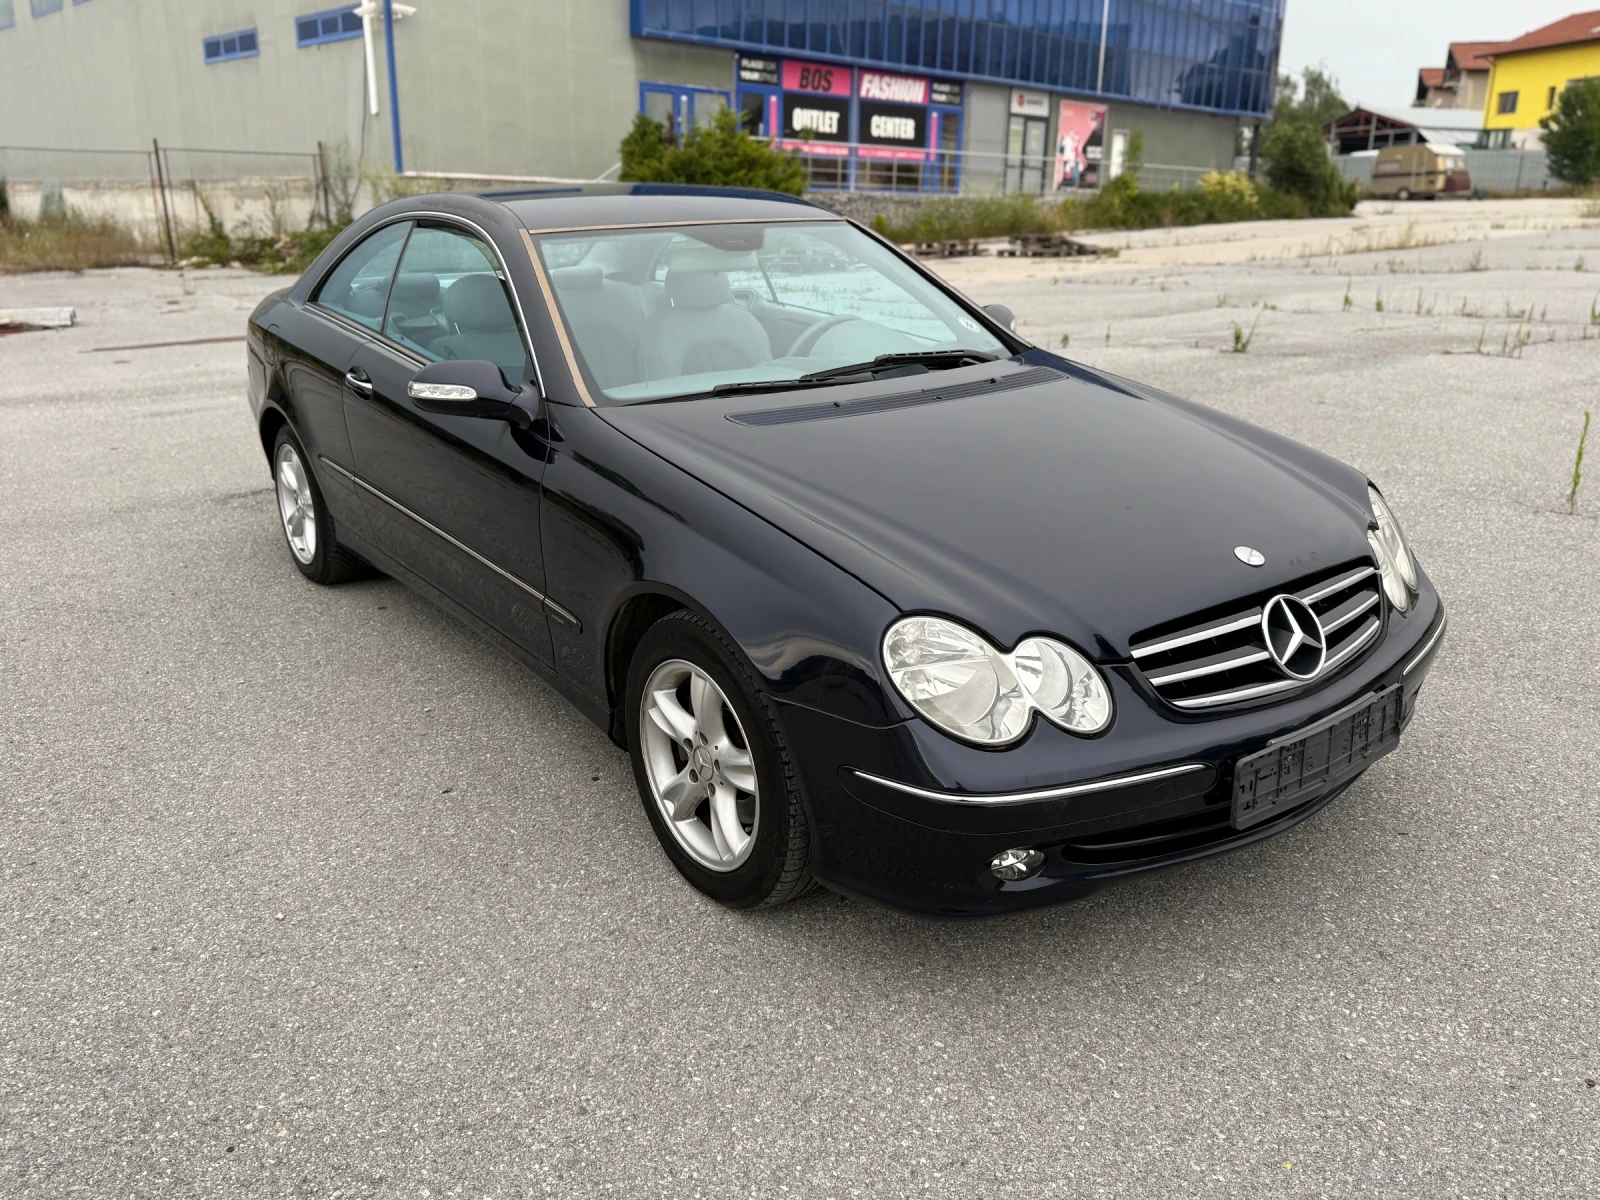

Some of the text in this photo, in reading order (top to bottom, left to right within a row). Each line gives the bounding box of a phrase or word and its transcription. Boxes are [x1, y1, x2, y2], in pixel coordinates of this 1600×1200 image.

[800, 67, 833, 92] BOS
[860, 73, 926, 104] FASHION
[792, 107, 840, 134] OUTLET
[870, 114, 916, 140] CENTER
